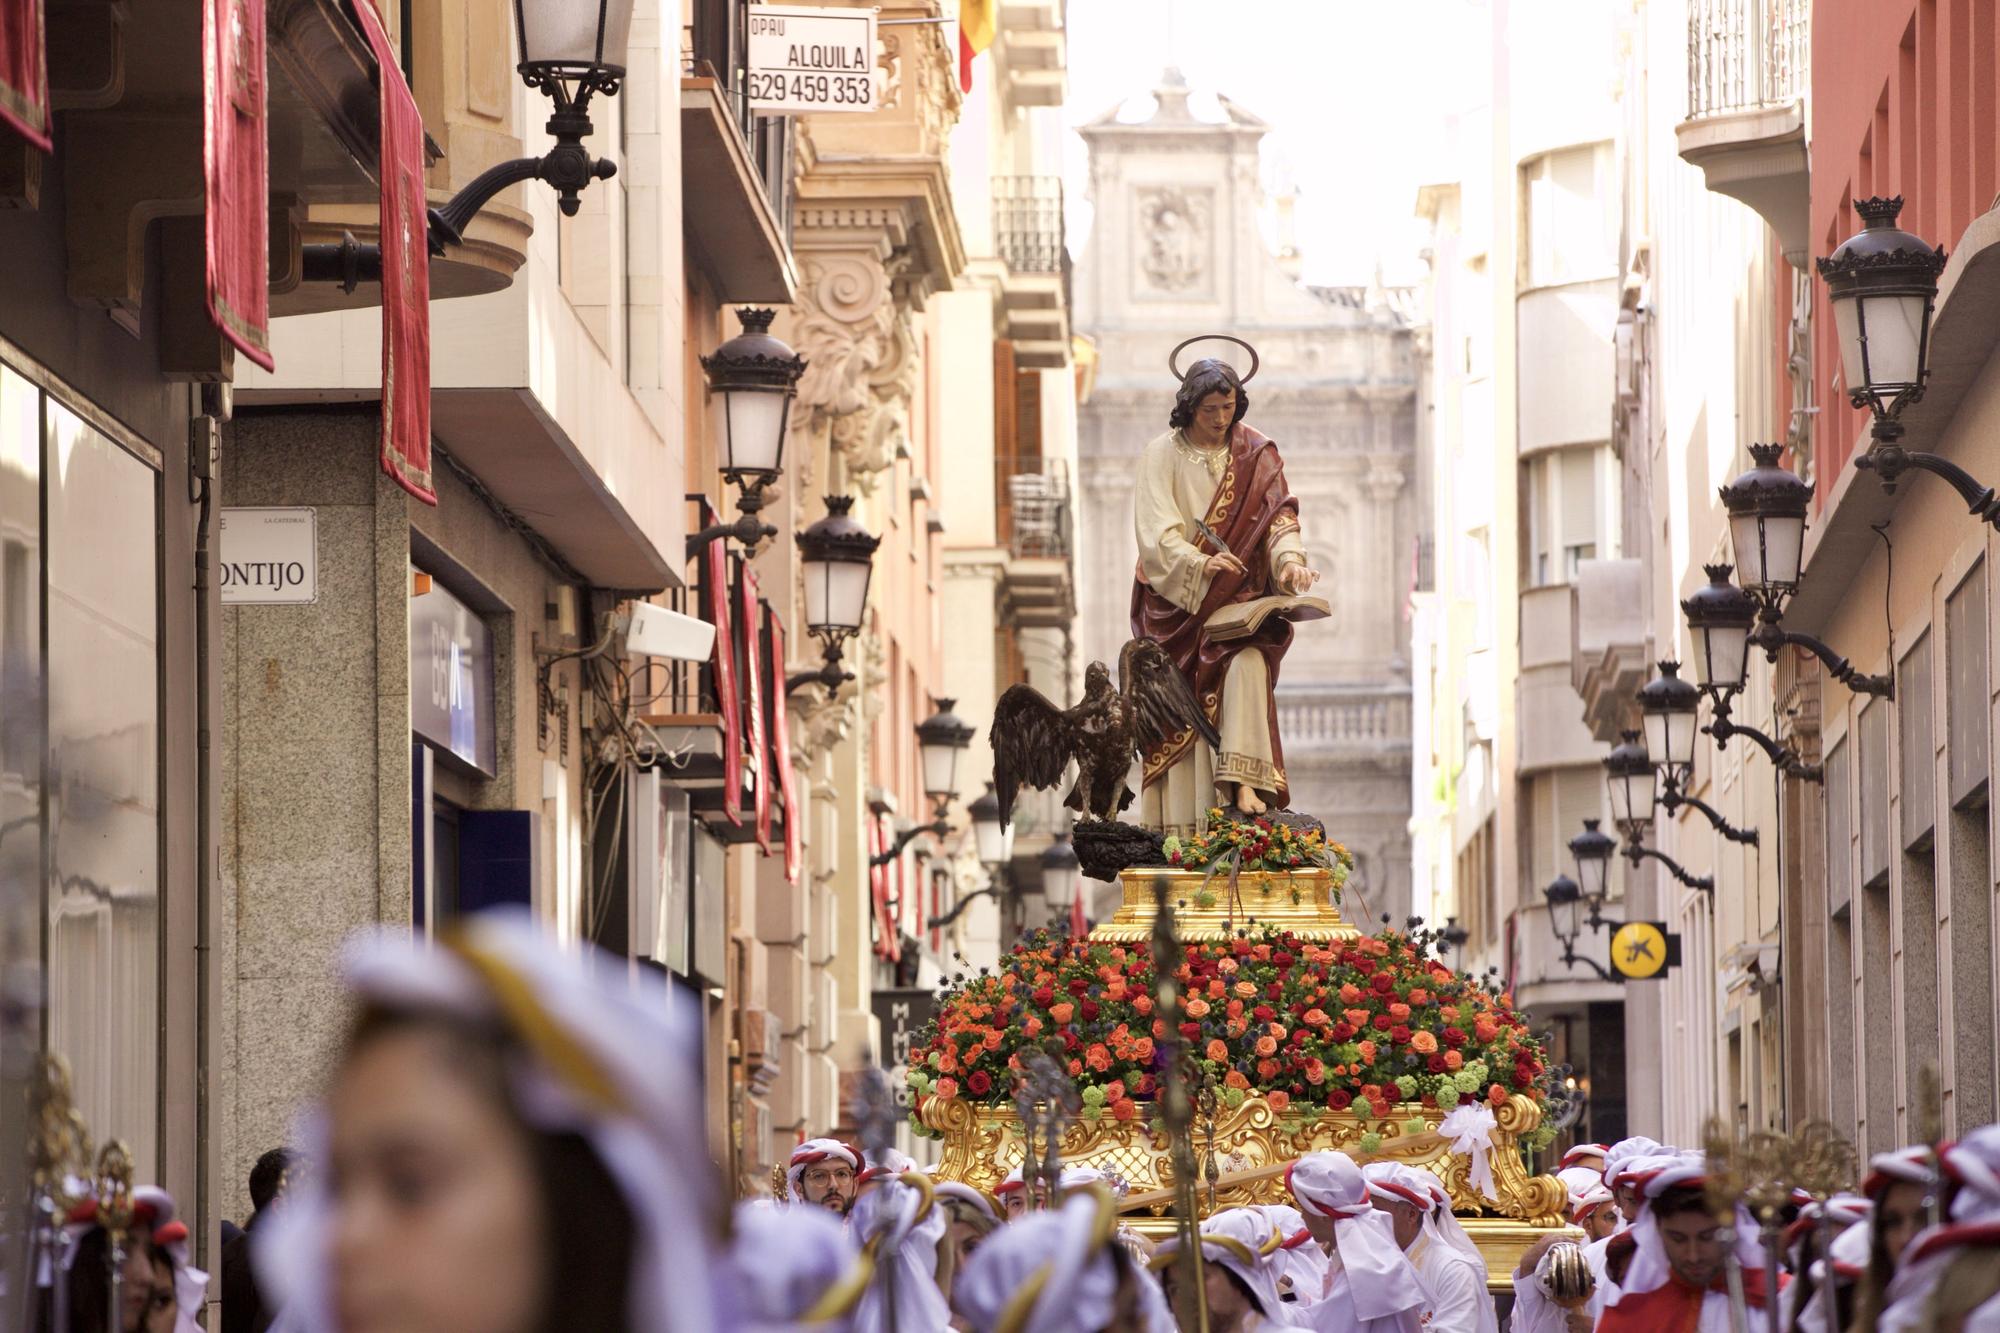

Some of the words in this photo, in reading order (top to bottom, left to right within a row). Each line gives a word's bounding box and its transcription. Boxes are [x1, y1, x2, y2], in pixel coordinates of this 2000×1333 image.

[788, 44, 865, 69] ALQUILA
[750, 73, 786, 101] 629
[790, 75, 829, 103] 459
[833, 76, 870, 104] 353
